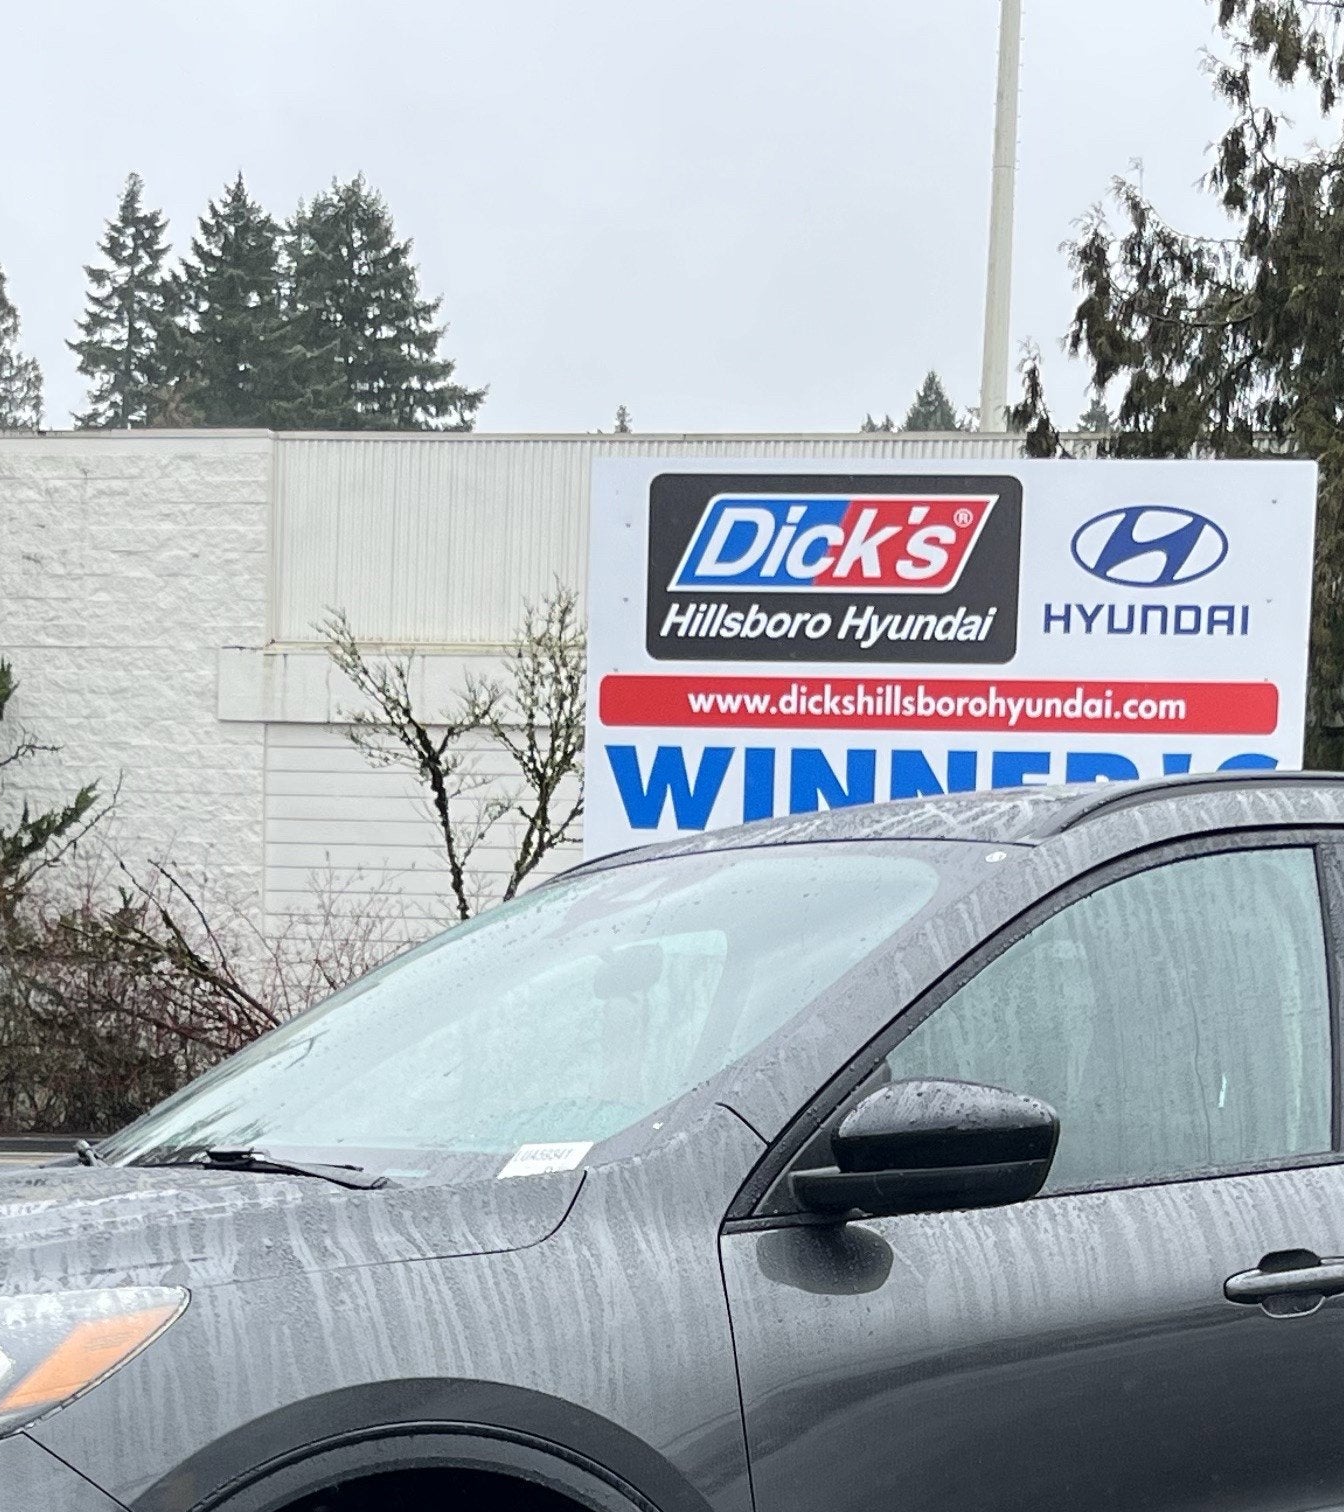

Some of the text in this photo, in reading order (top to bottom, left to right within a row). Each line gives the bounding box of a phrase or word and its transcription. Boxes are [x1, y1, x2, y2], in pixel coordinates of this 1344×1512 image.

[659, 603, 998, 649] Hillsboro Hyundai
[1043, 603, 1250, 636] HYUNDAI
[687, 683, 1186, 726] www.dickshillsborohyundai.com
